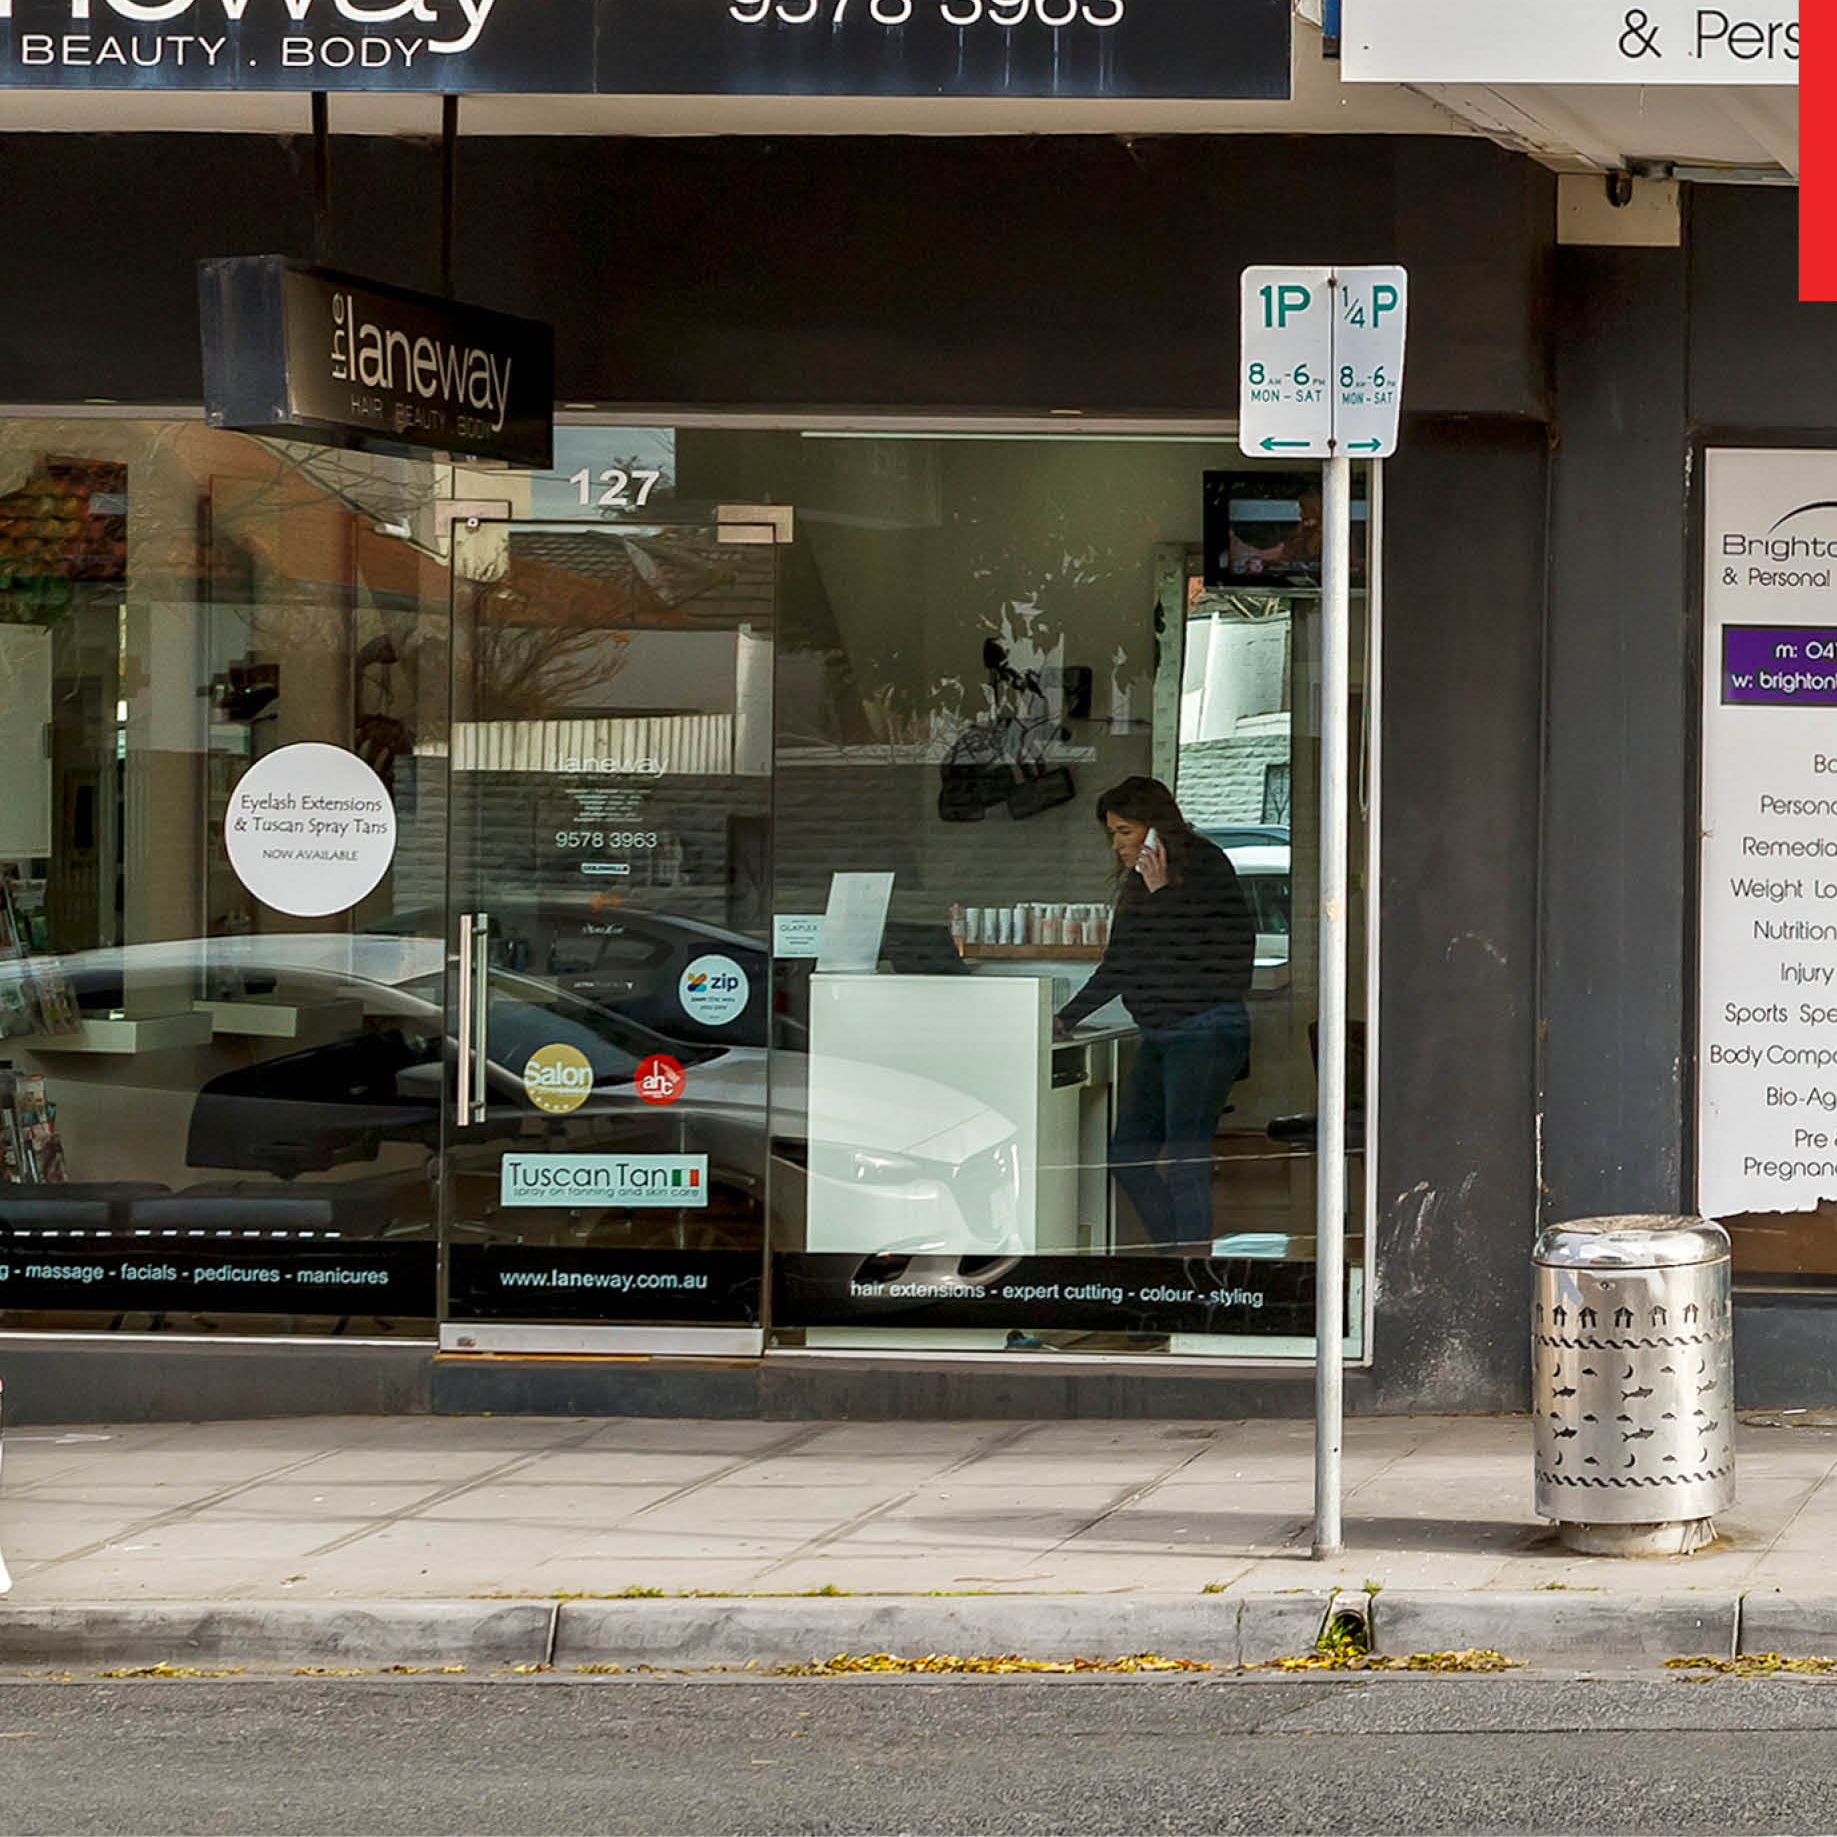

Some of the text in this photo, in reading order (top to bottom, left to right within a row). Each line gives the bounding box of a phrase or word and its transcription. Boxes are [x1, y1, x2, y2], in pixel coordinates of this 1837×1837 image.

[1619, 9, 1662, 58] &
[22, 35, 424, 67] BEAUTY BODY
[1259, 284, 1311, 328] 1P
[347, 295, 512, 432] laneway
[568, 470, 660, 507] 127
[1722, 567, 1738, 586] &
[1749, 567, 1830, 588] Personal
[1775, 645, 1798, 659] m:
[1732, 674, 1753, 688] w:
[241, 793, 382, 814] Eyelash Extensions
[234, 817, 388, 838] & Tuscan Spray Tans
[555, 832, 657, 848] 9578 3963
[262, 849, 359, 860] NOW AVAILABLE
[1730, 878, 1803, 903] Weight
[710, 973, 739, 992] zip
[1780, 962, 1834, 986] Injury
[1725, 1002, 1788, 1025] Sports
[1710, 1044, 1763, 1068] Body
[523, 1060, 594, 1087] Salon
[1794, 1129, 1828, 1148] Pre
[508, 1162, 668, 1188] Tuscan Tan
[25, 1263, 104, 1283] massage
[120, 1263, 177, 1281] facials
[194, 1264, 281, 1284] pedicures
[297, 1266, 389, 1285] manicures
[500, 1269, 708, 1292] www.laneway.com.au
[850, 1281, 1264, 1308] hair extensions expert cutting colour styling
